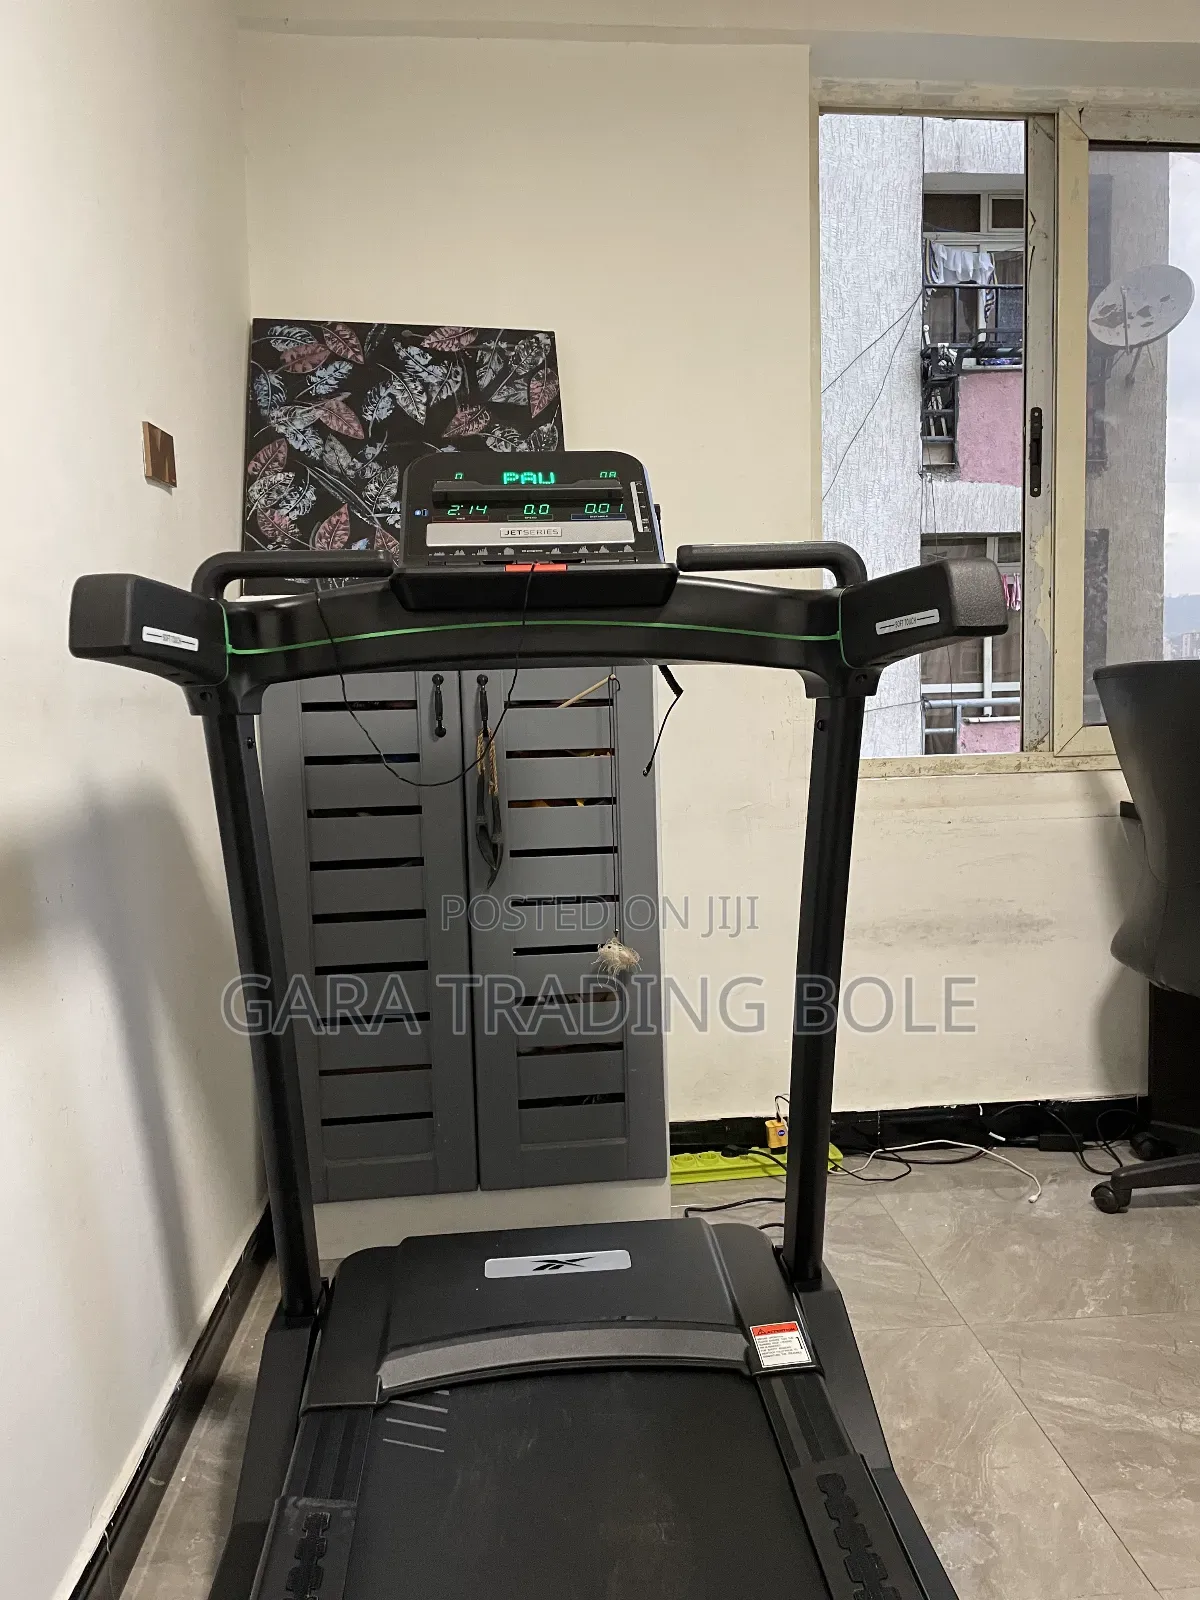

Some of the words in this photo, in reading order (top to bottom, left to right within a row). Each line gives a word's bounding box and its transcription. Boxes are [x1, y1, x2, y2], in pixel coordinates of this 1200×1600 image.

[503, 471, 556, 485] PAU
[447, 504, 488, 516] 2:14
[523, 503, 550, 515] 0.0
[584, 503, 624, 514] 0.01
[504, 528, 559, 536] JETSERIES
